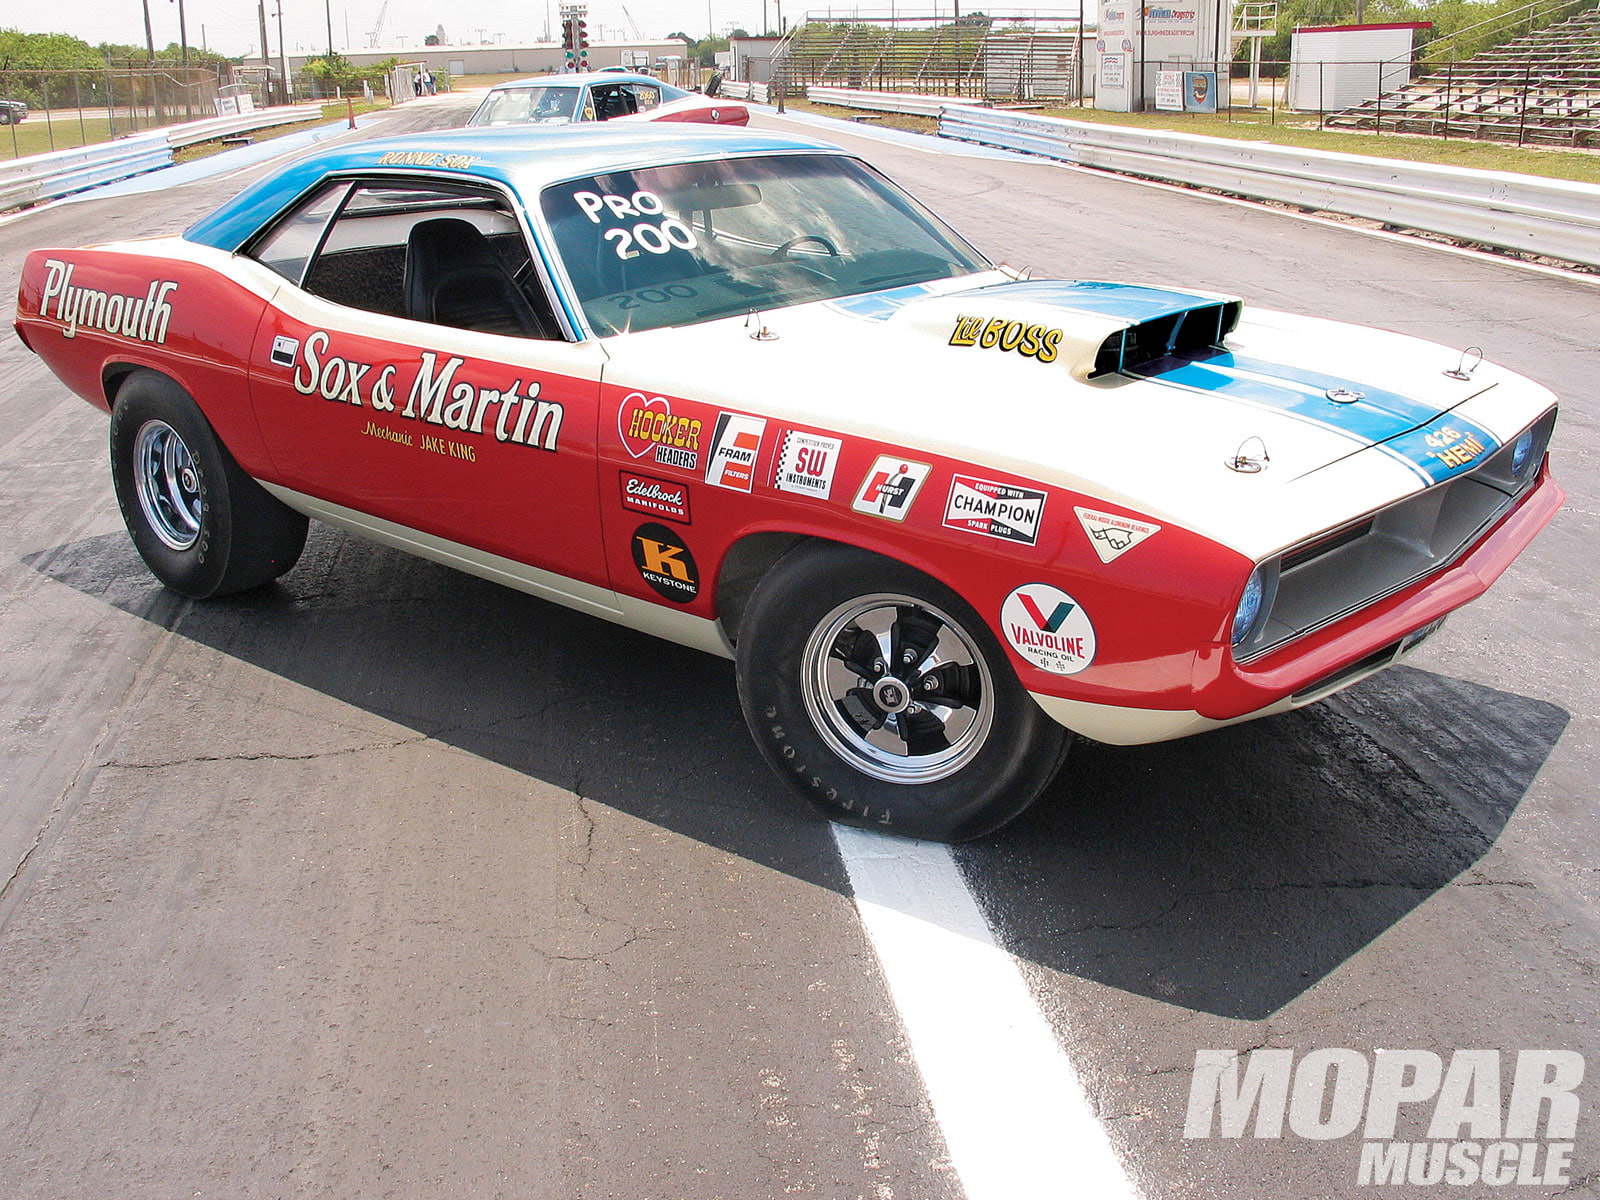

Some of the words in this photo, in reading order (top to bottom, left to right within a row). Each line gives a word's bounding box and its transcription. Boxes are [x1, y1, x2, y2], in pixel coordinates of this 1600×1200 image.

[376, 151, 444, 167] RONNIE
[436, 154, 482, 169] SOX
[573, 191, 664, 224] PRO
[604, 219, 698, 260] 200
[39, 258, 178, 344] Plymouth
[980, 317, 1063, 363] BOSS
[294, 330, 371, 406] Sox
[371, 365, 396, 412] &
[401, 351, 564, 453] Martin
[628, 408, 702, 450] HOOKER
[1424, 426, 1462, 448] 426
[361, 421, 413, 446] Mechanic
[420, 435, 446, 455] JAKE
[448, 441, 476, 463] KING
[656, 446, 697, 469] HEADERS
[718, 447, 752, 462] FRAM
[795, 448, 828, 477] SW
[724, 470, 750, 480] FILTERS
[785, 473, 827, 490] INSTRUMENTS
[626, 479, 682, 505] Edelbrock
[875, 484, 904, 496] HURST
[974, 483, 1007, 497] EQUIPPED
[1007, 489, 1024, 499] WITH
[626, 496, 685, 515] MANIFOLDS
[954, 494, 1035, 525] CHAMPION
[967, 519, 988, 530] SPARK
[990, 524, 1011, 535] PLUGS
[636, 536, 694, 584] K
[642, 571, 697, 594] KEYSTONE
[1010, 622, 1085, 659] VALVOLINE
[1028, 647, 1058, 659] RACING
[1060, 653, 1075, 663] OIL
